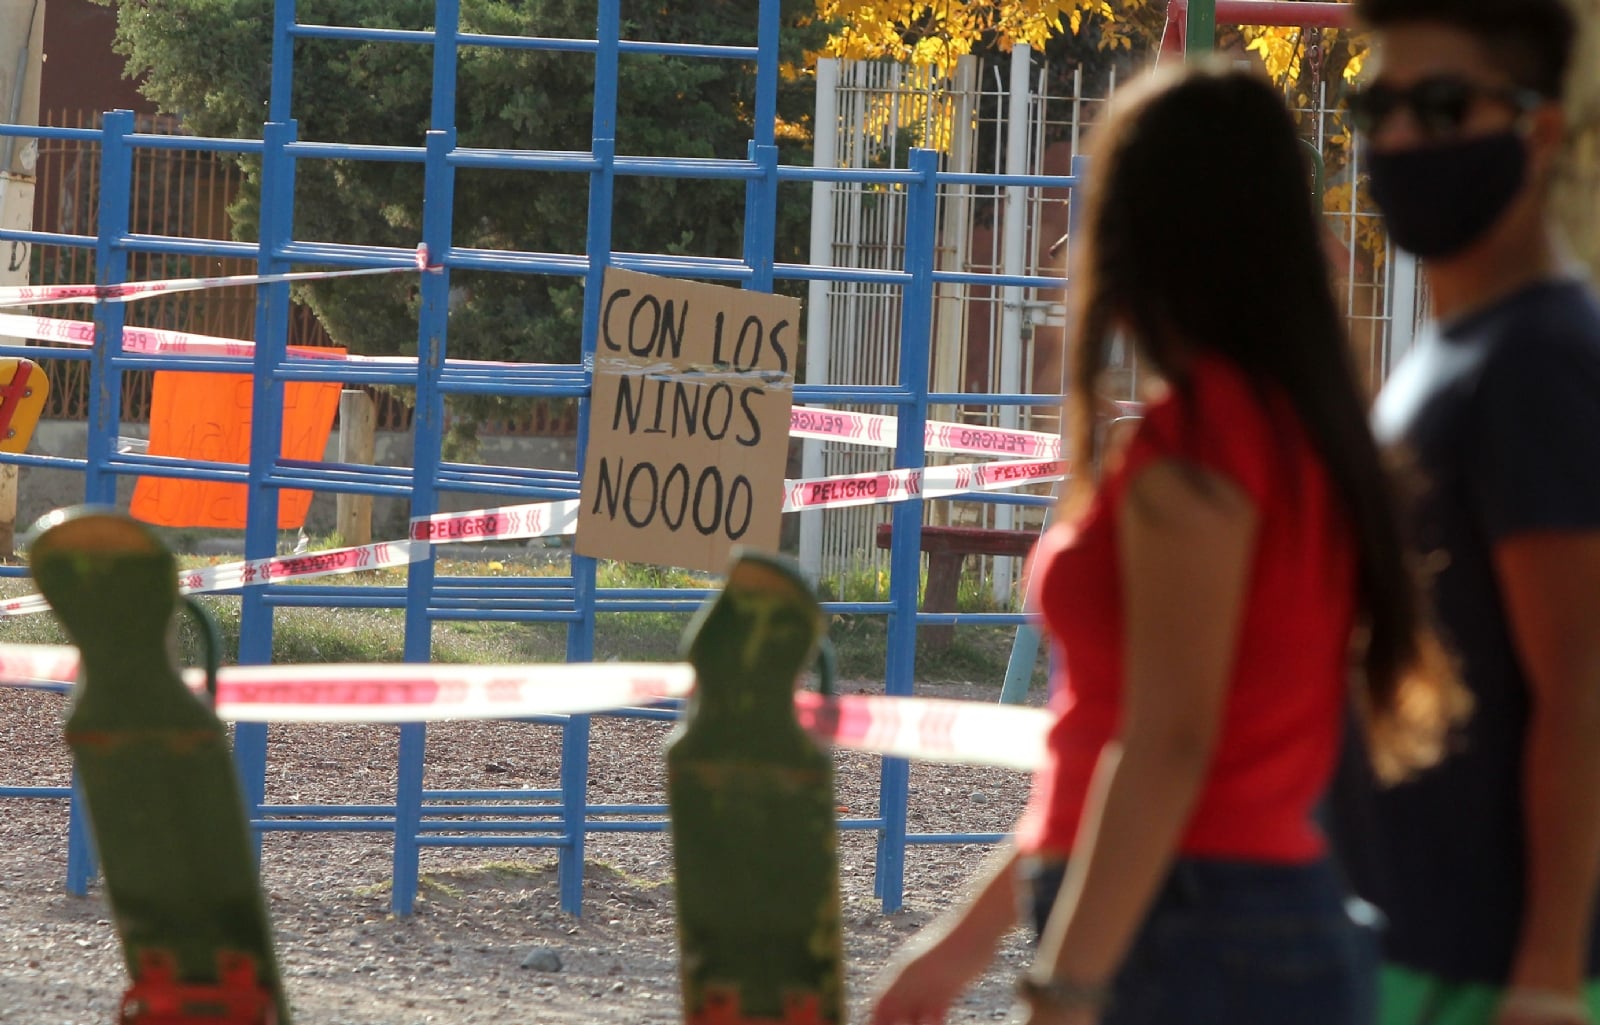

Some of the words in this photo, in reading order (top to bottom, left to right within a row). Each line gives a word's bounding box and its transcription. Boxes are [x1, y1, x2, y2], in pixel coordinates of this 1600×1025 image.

[603, 289, 688, 358] CON
[713, 311, 789, 383] LOS
[591, 456, 753, 541] NOOOO
[811, 479, 877, 501] PELIGRO
[426, 516, 497, 538] PELIGRO
